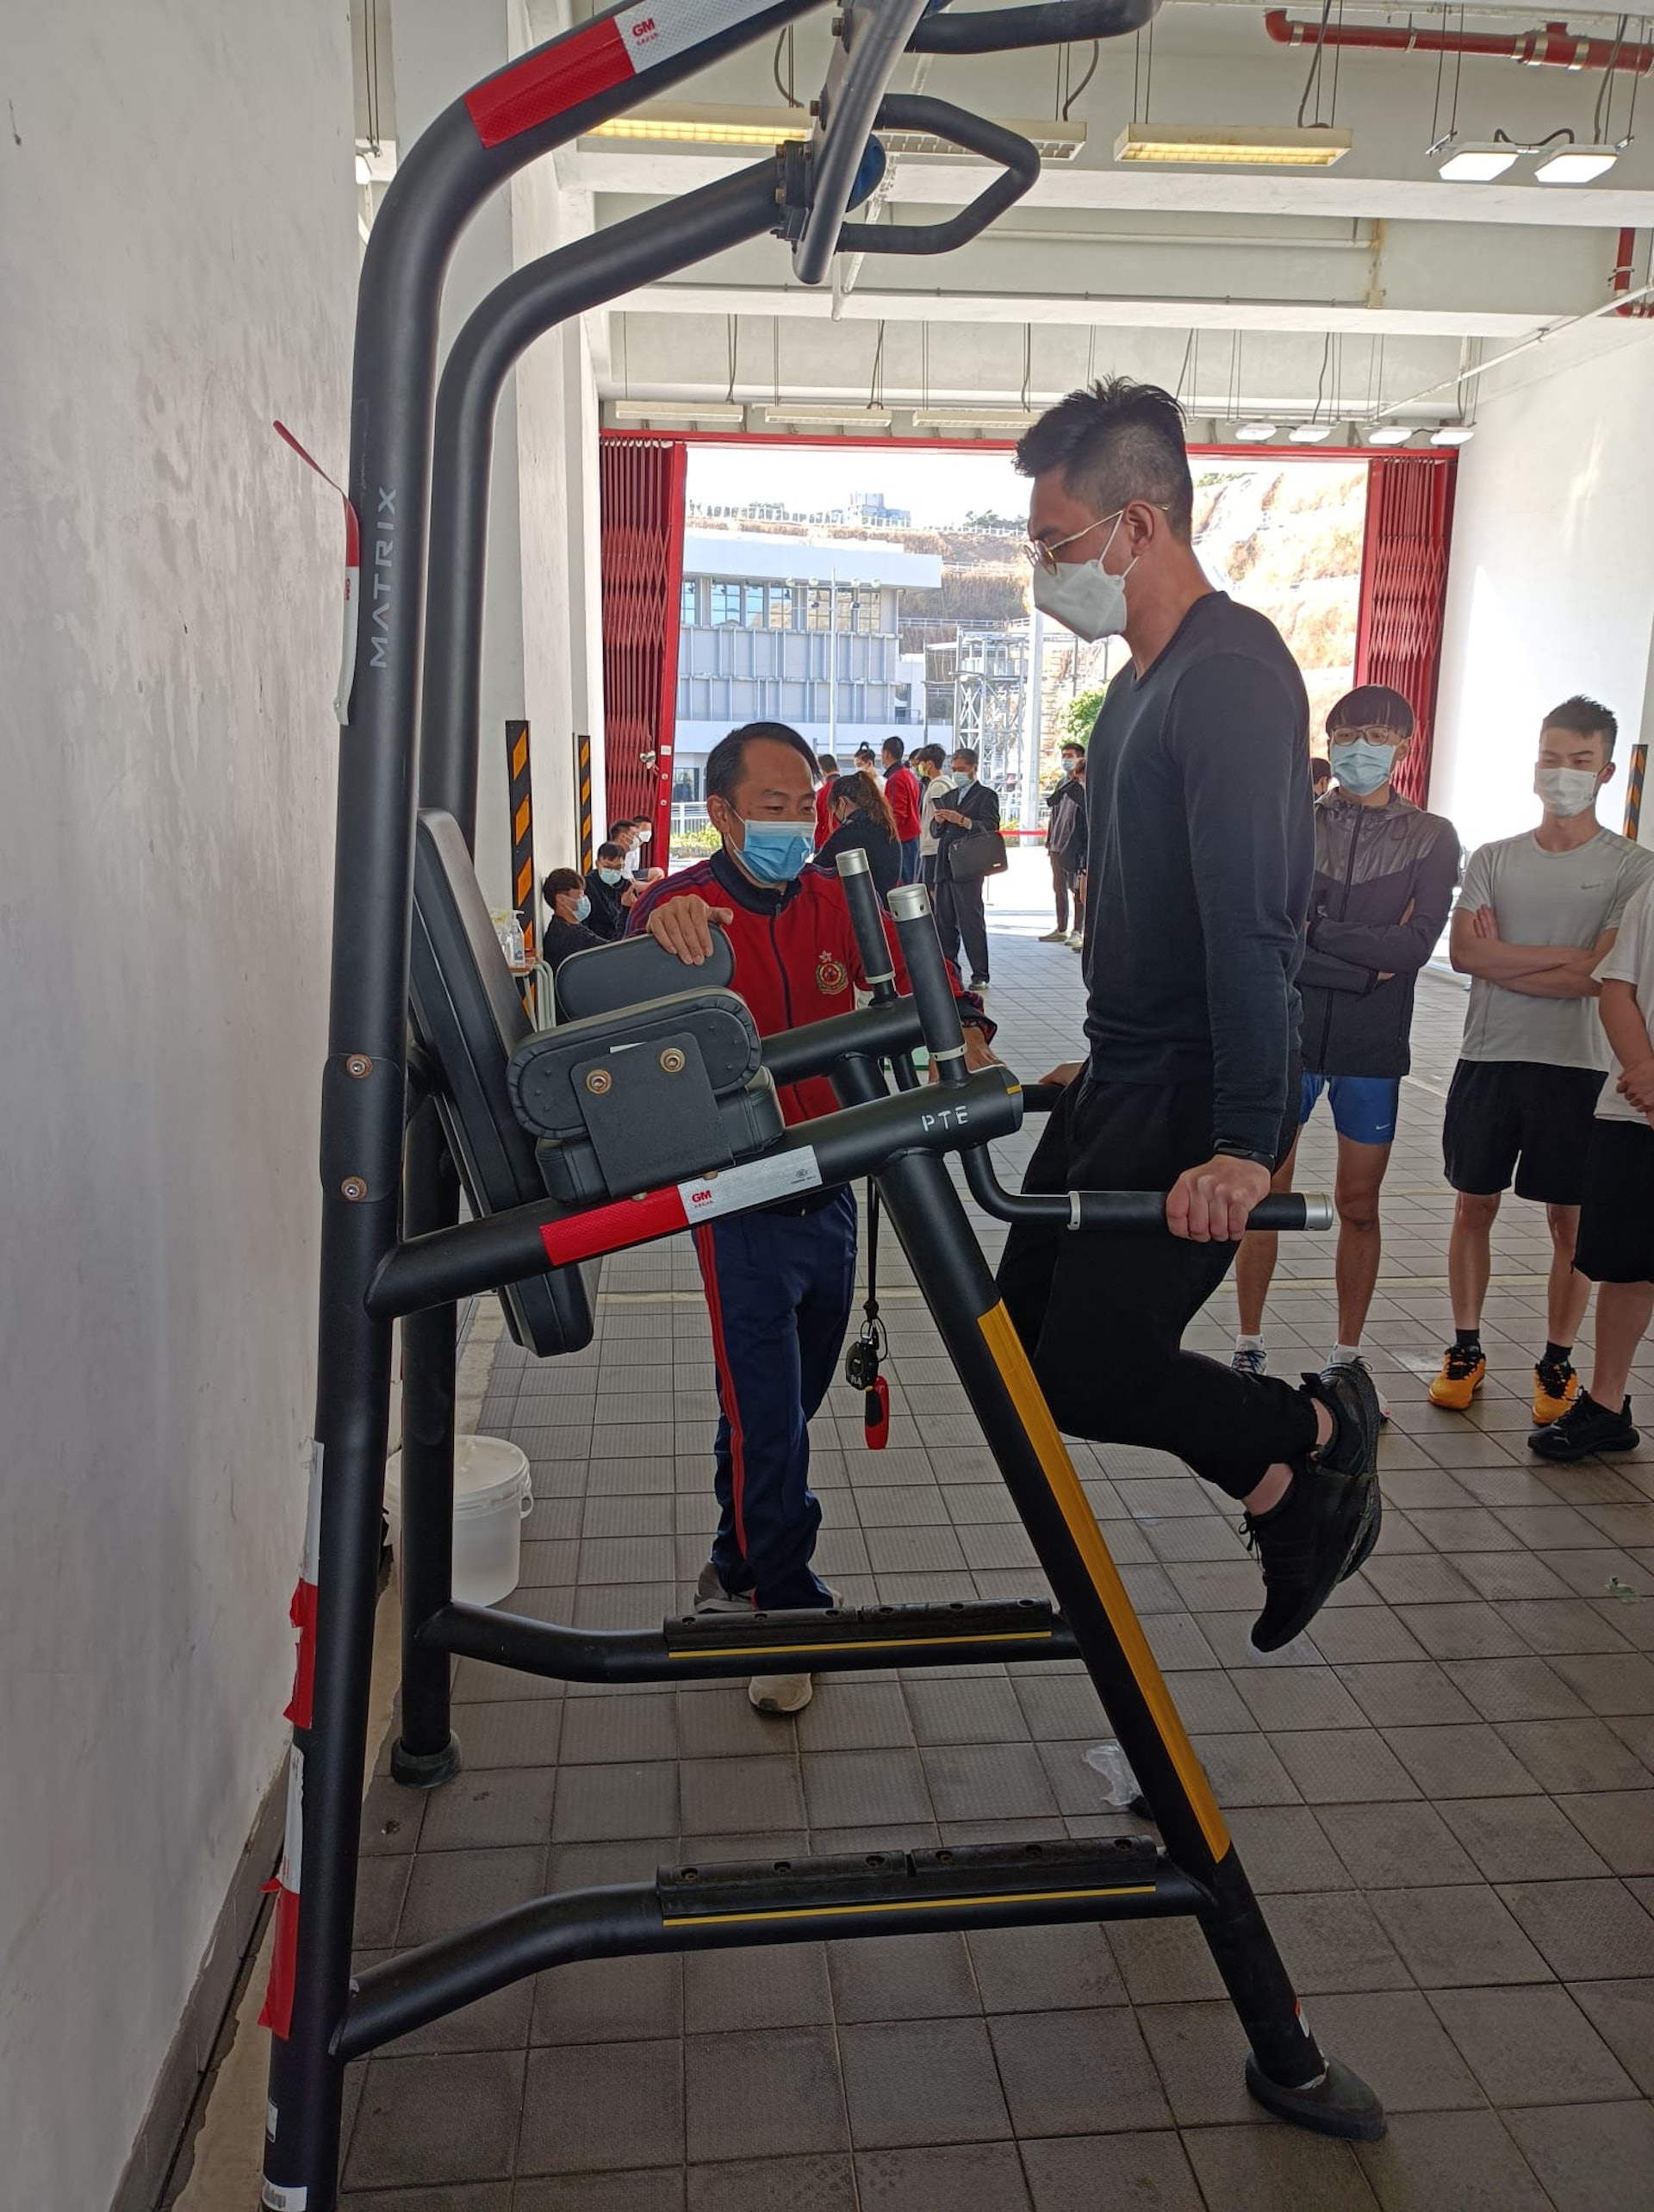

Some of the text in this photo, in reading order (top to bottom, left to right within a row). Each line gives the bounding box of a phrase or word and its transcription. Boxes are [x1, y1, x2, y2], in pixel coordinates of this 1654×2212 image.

[632, 18, 656, 37] GM
[370, 486, 397, 669] MATRIX
[921, 1105, 968, 1132] PTE
[692, 1190, 712, 1203] GM
